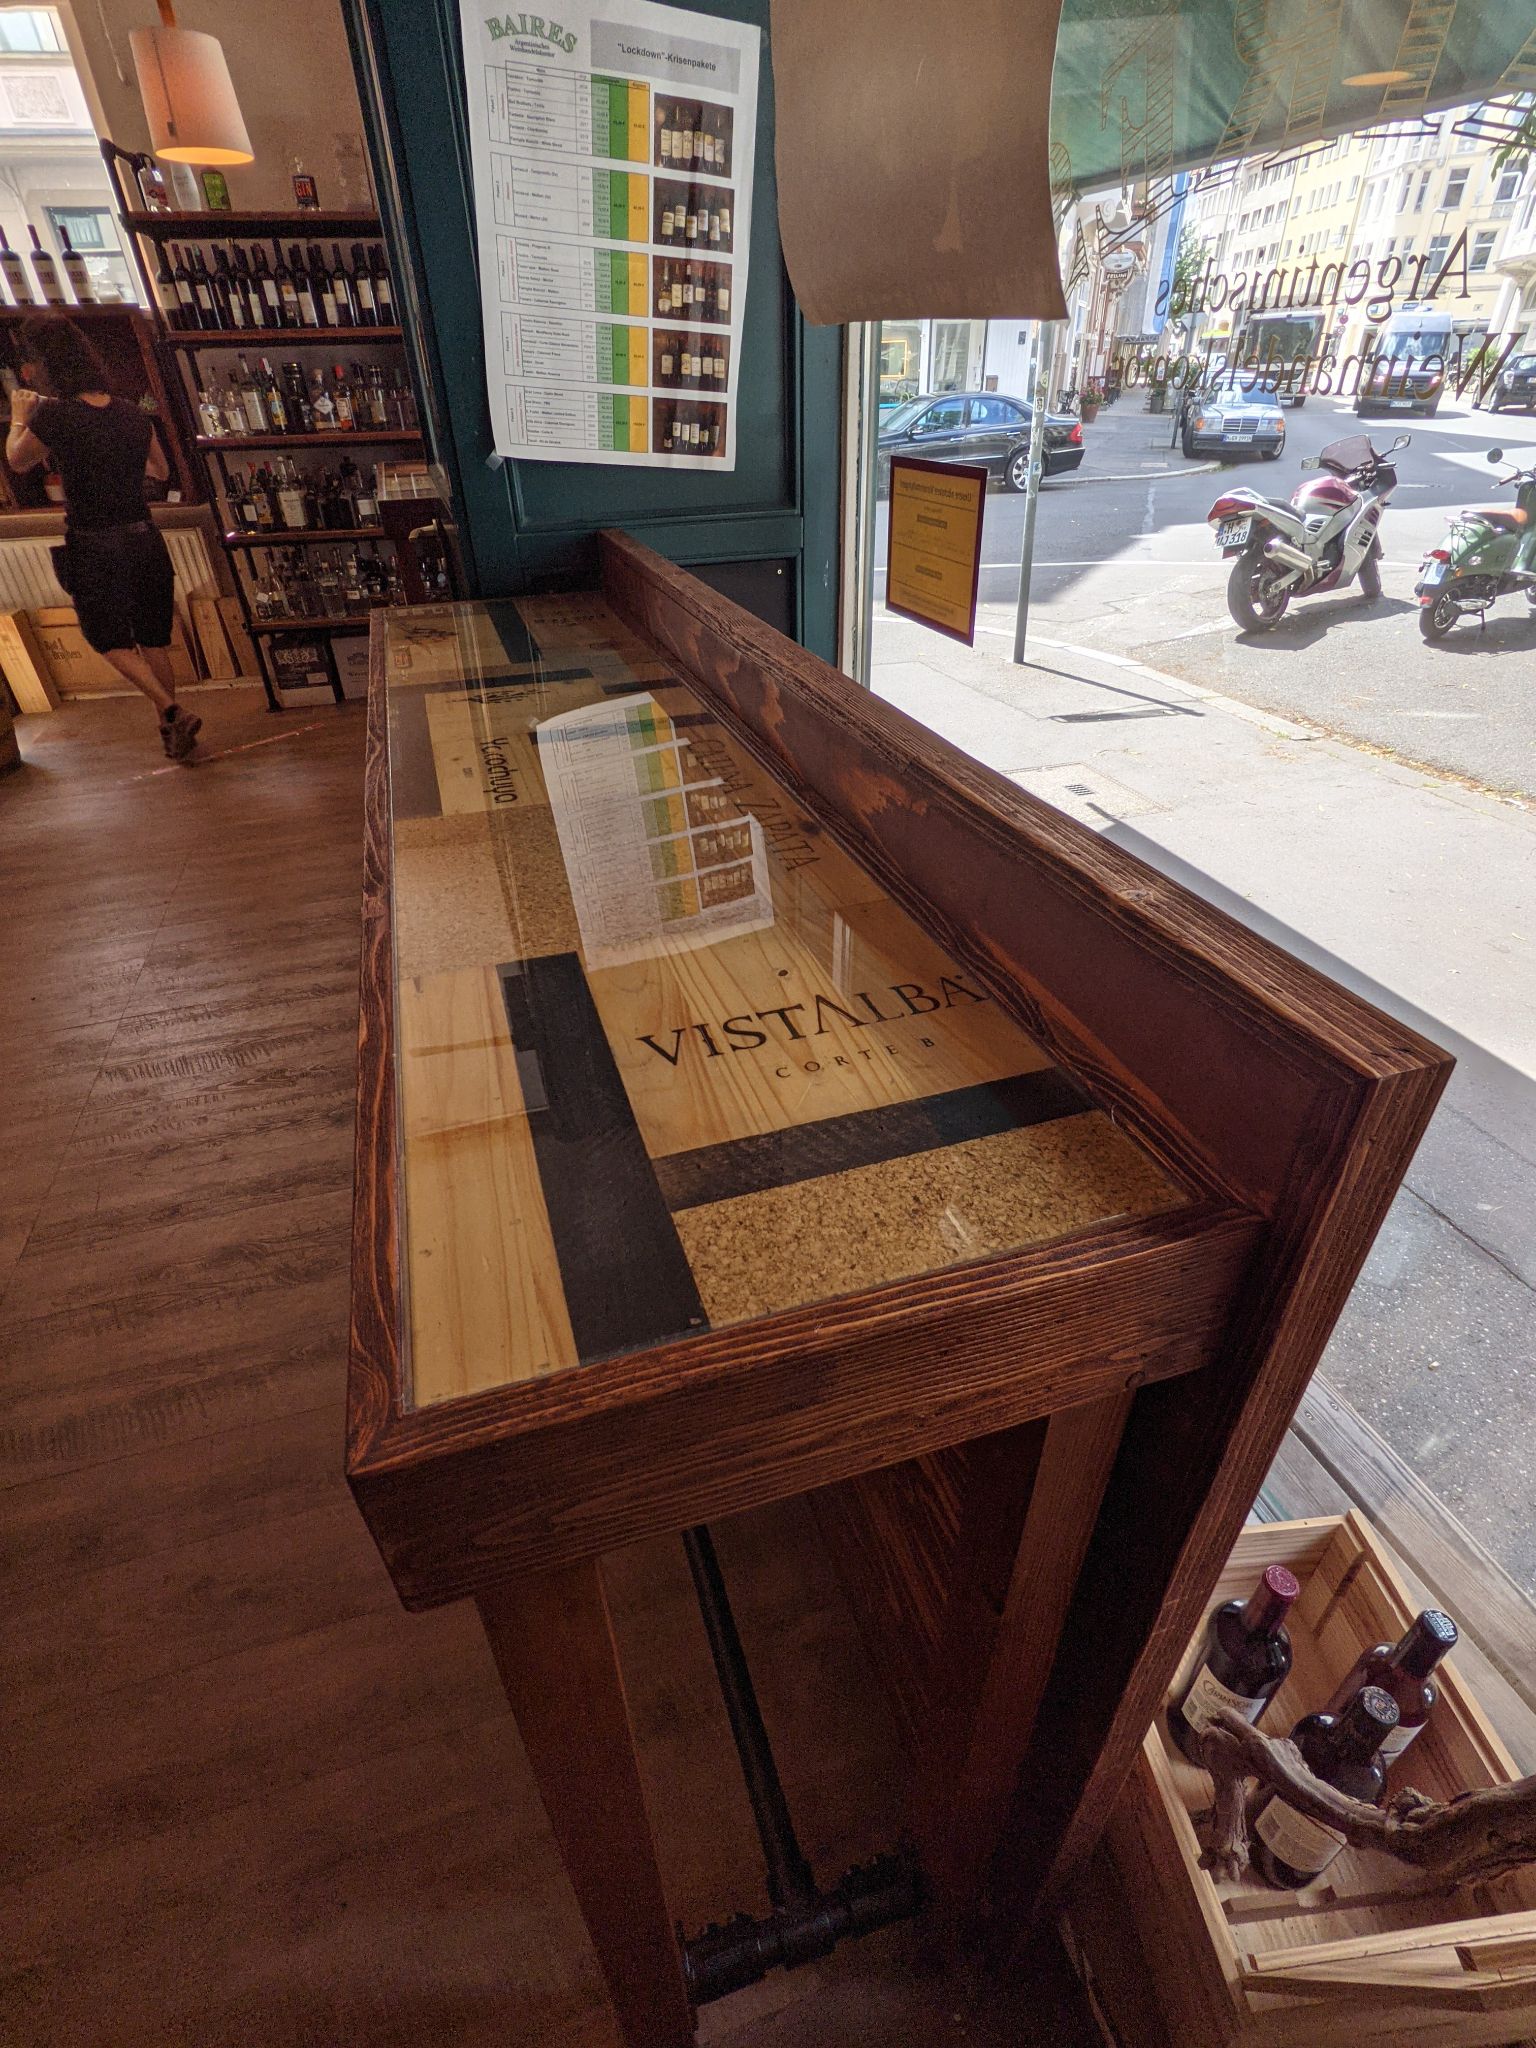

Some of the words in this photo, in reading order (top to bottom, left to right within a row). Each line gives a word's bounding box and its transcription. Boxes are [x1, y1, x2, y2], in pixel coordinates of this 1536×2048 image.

[484, 14, 577, 53] BAIRES
[735, 798, 821, 871] ZAPATA
[635, 975, 992, 1067] VISTALBA
[775, 1044, 899, 1079] CORTE
[920, 1036, 935, 1048] B
